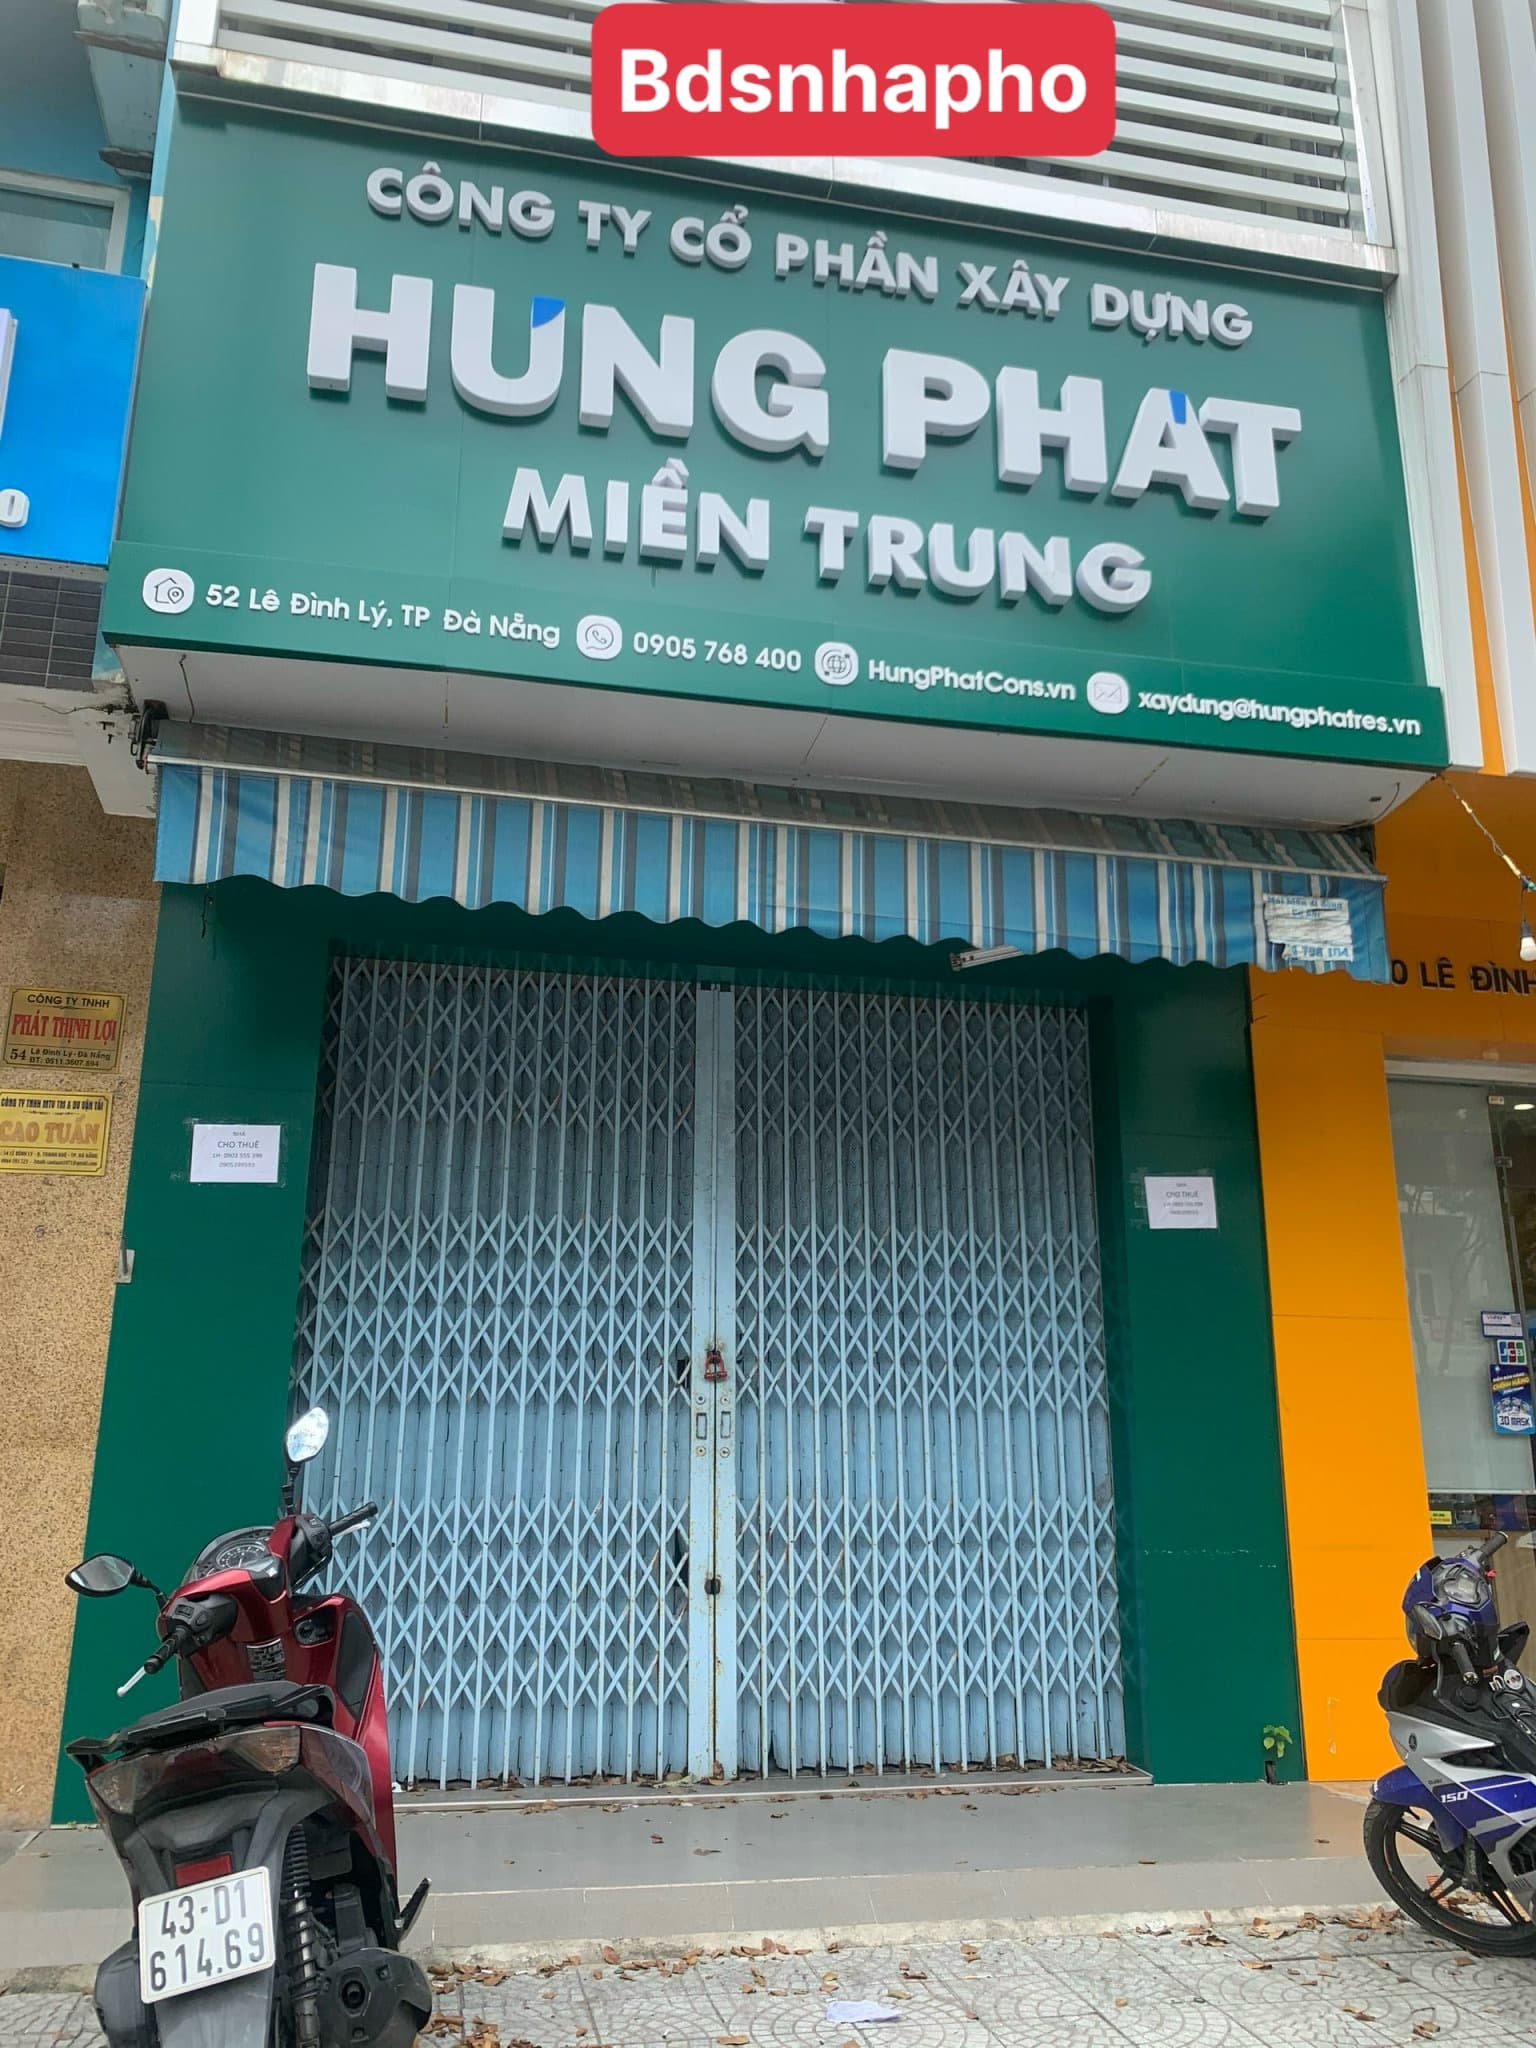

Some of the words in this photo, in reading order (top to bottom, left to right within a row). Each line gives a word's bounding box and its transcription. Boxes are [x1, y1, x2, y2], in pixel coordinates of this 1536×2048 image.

[366, 161, 556, 238] CÔNG
[578, 199, 652, 253] TY
[670, 204, 752, 269] CỔ
[775, 230, 938, 300] PHẦN
[958, 259, 1070, 318] XÂY
[1090, 283, 1254, 346] DỰNG
[882, 347, 1302, 517] PHÁT
[502, 457, 771, 571] MIỀN
[803, 505, 1152, 613] TRUNG
[205, 584, 240, 608] 52
[249, 588, 281, 612] Lê
[290, 591, 350, 620] Đình
[358, 599, 393, 629] Lý,
[401, 604, 431, 628] TP
[443, 609, 481, 635] Đà
[489, 612, 561, 649] Nẵng
[633, 631, 697, 660] 0905
[704, 639, 749, 666] 768
[755, 647, 802, 672] 400
[868, 658, 1077, 701] HungPhatCons.vn
[1138, 689, 1422, 737] xaydung@hungphatres.vn
[1420, 957, 1456, 989] LÊ
[65, 996, 78, 1006] TY
[82, 998, 110, 1008] TNHH
[11, 1009, 49, 1037] PHÁT
[52, 1016, 92, 1044] THỊNH
[93, 1018, 118, 1046] LỢI
[10, 1048, 26, 1061] 54
[0, 1120, 40, 1143] CAO
[217, 1141, 236, 1149] CHO
[238, 1140, 260, 1149] THUÊ
[1440, 1790, 1468, 1804] 150
[161, 1879, 247, 1939] 43-D1
[150, 1922, 265, 1992] 614.69
